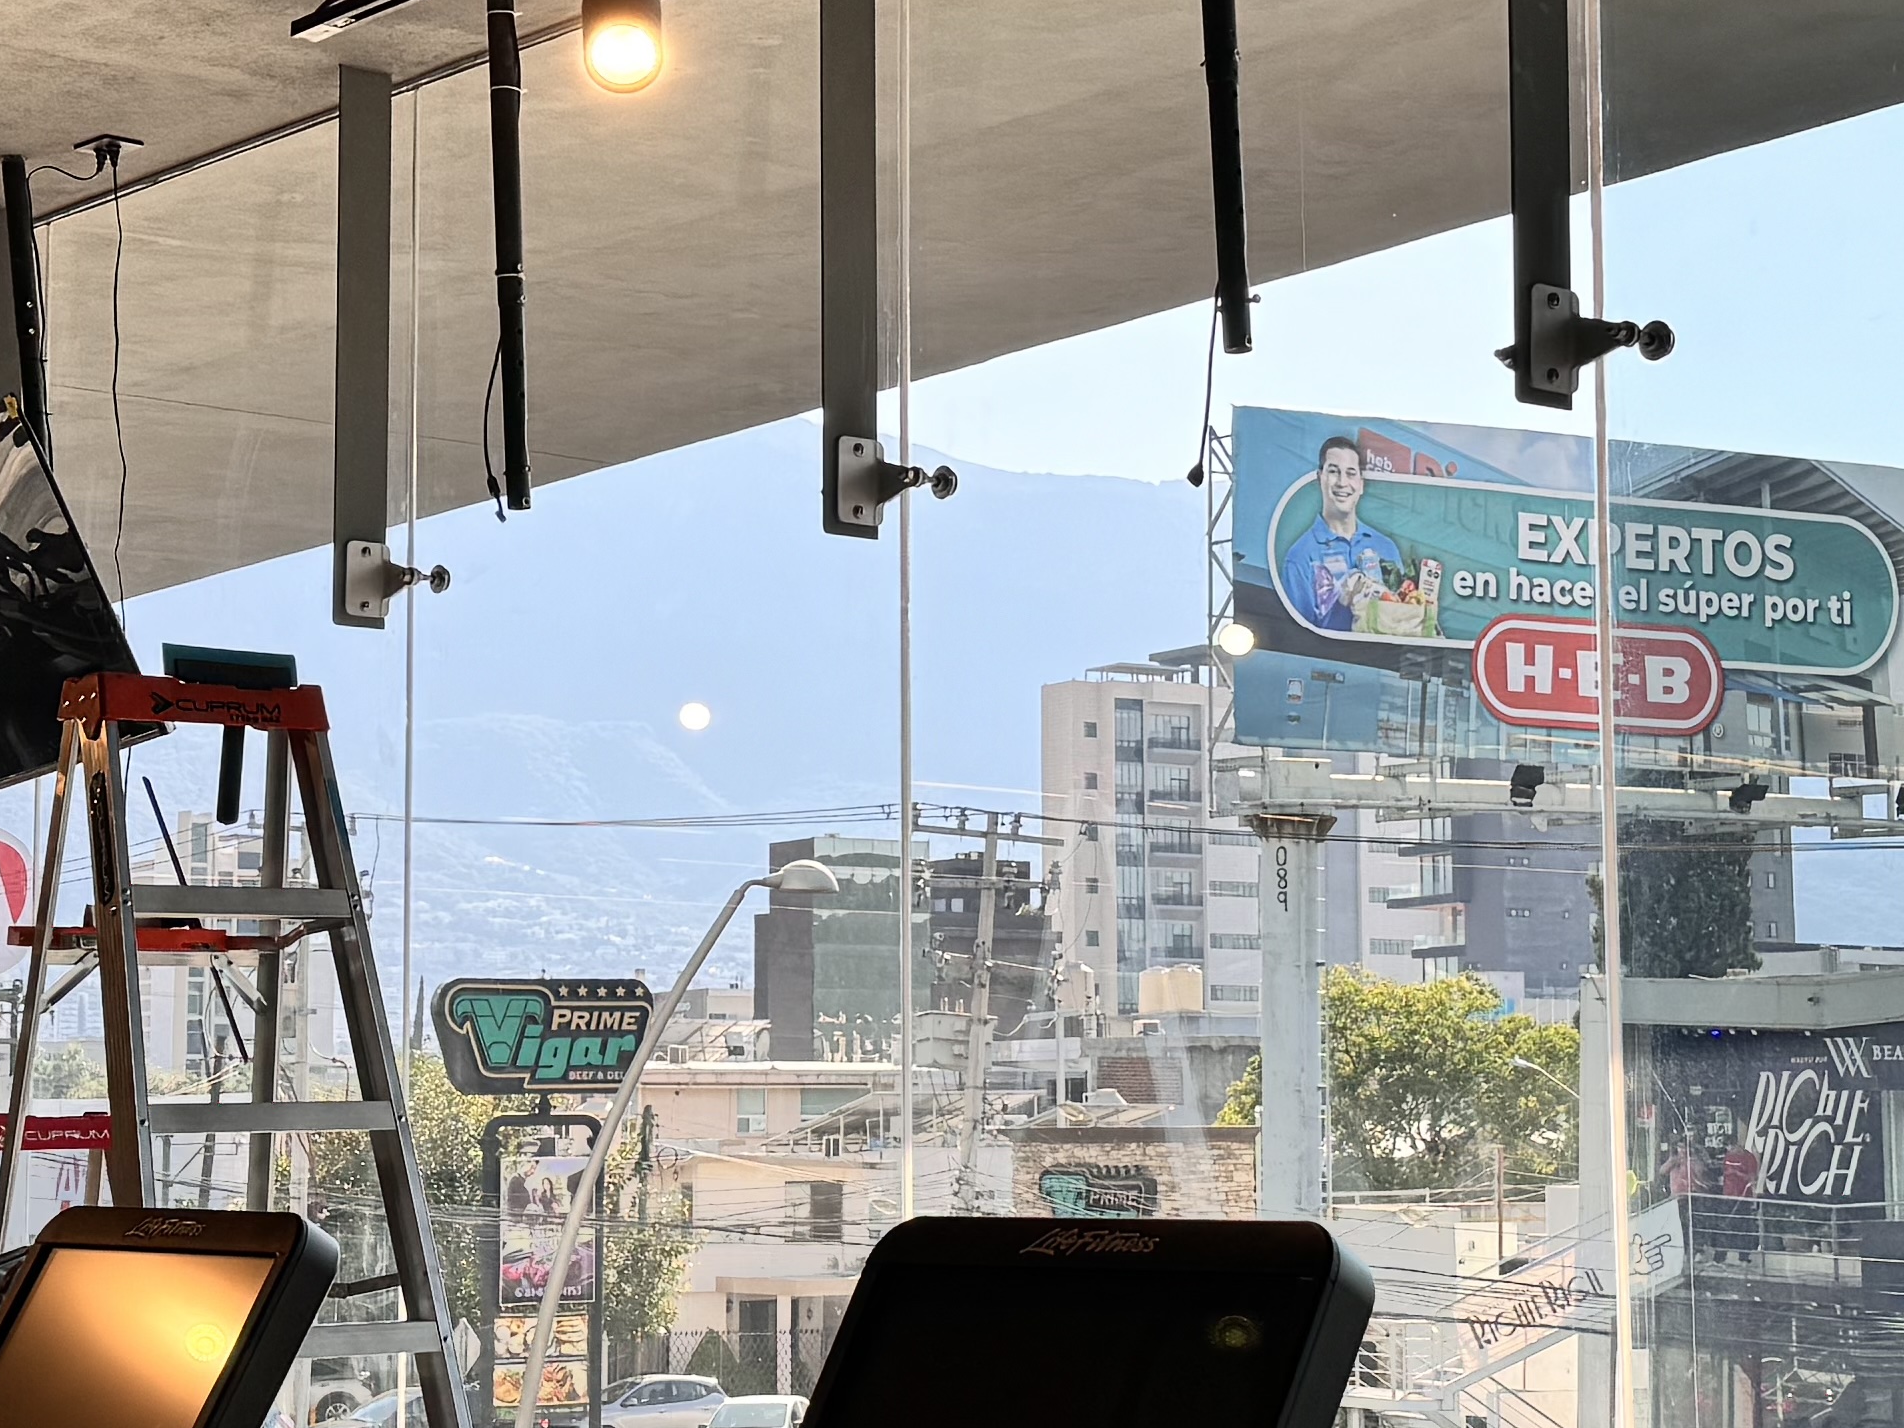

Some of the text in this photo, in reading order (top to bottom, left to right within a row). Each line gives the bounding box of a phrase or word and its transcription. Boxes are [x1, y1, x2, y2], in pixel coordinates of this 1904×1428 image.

[1518, 511, 1796, 582] EXPERTOS
[1453, 567, 1853, 628] en hace el súper por ti
[176, 699, 281, 715] CUPRUM
[453, 995, 637, 1079] Vigar
[550, 1008, 641, 1031] PRIME
[24, 1129, 111, 1141] CUPRUM
[1754, 1121, 1863, 1197] RICH
